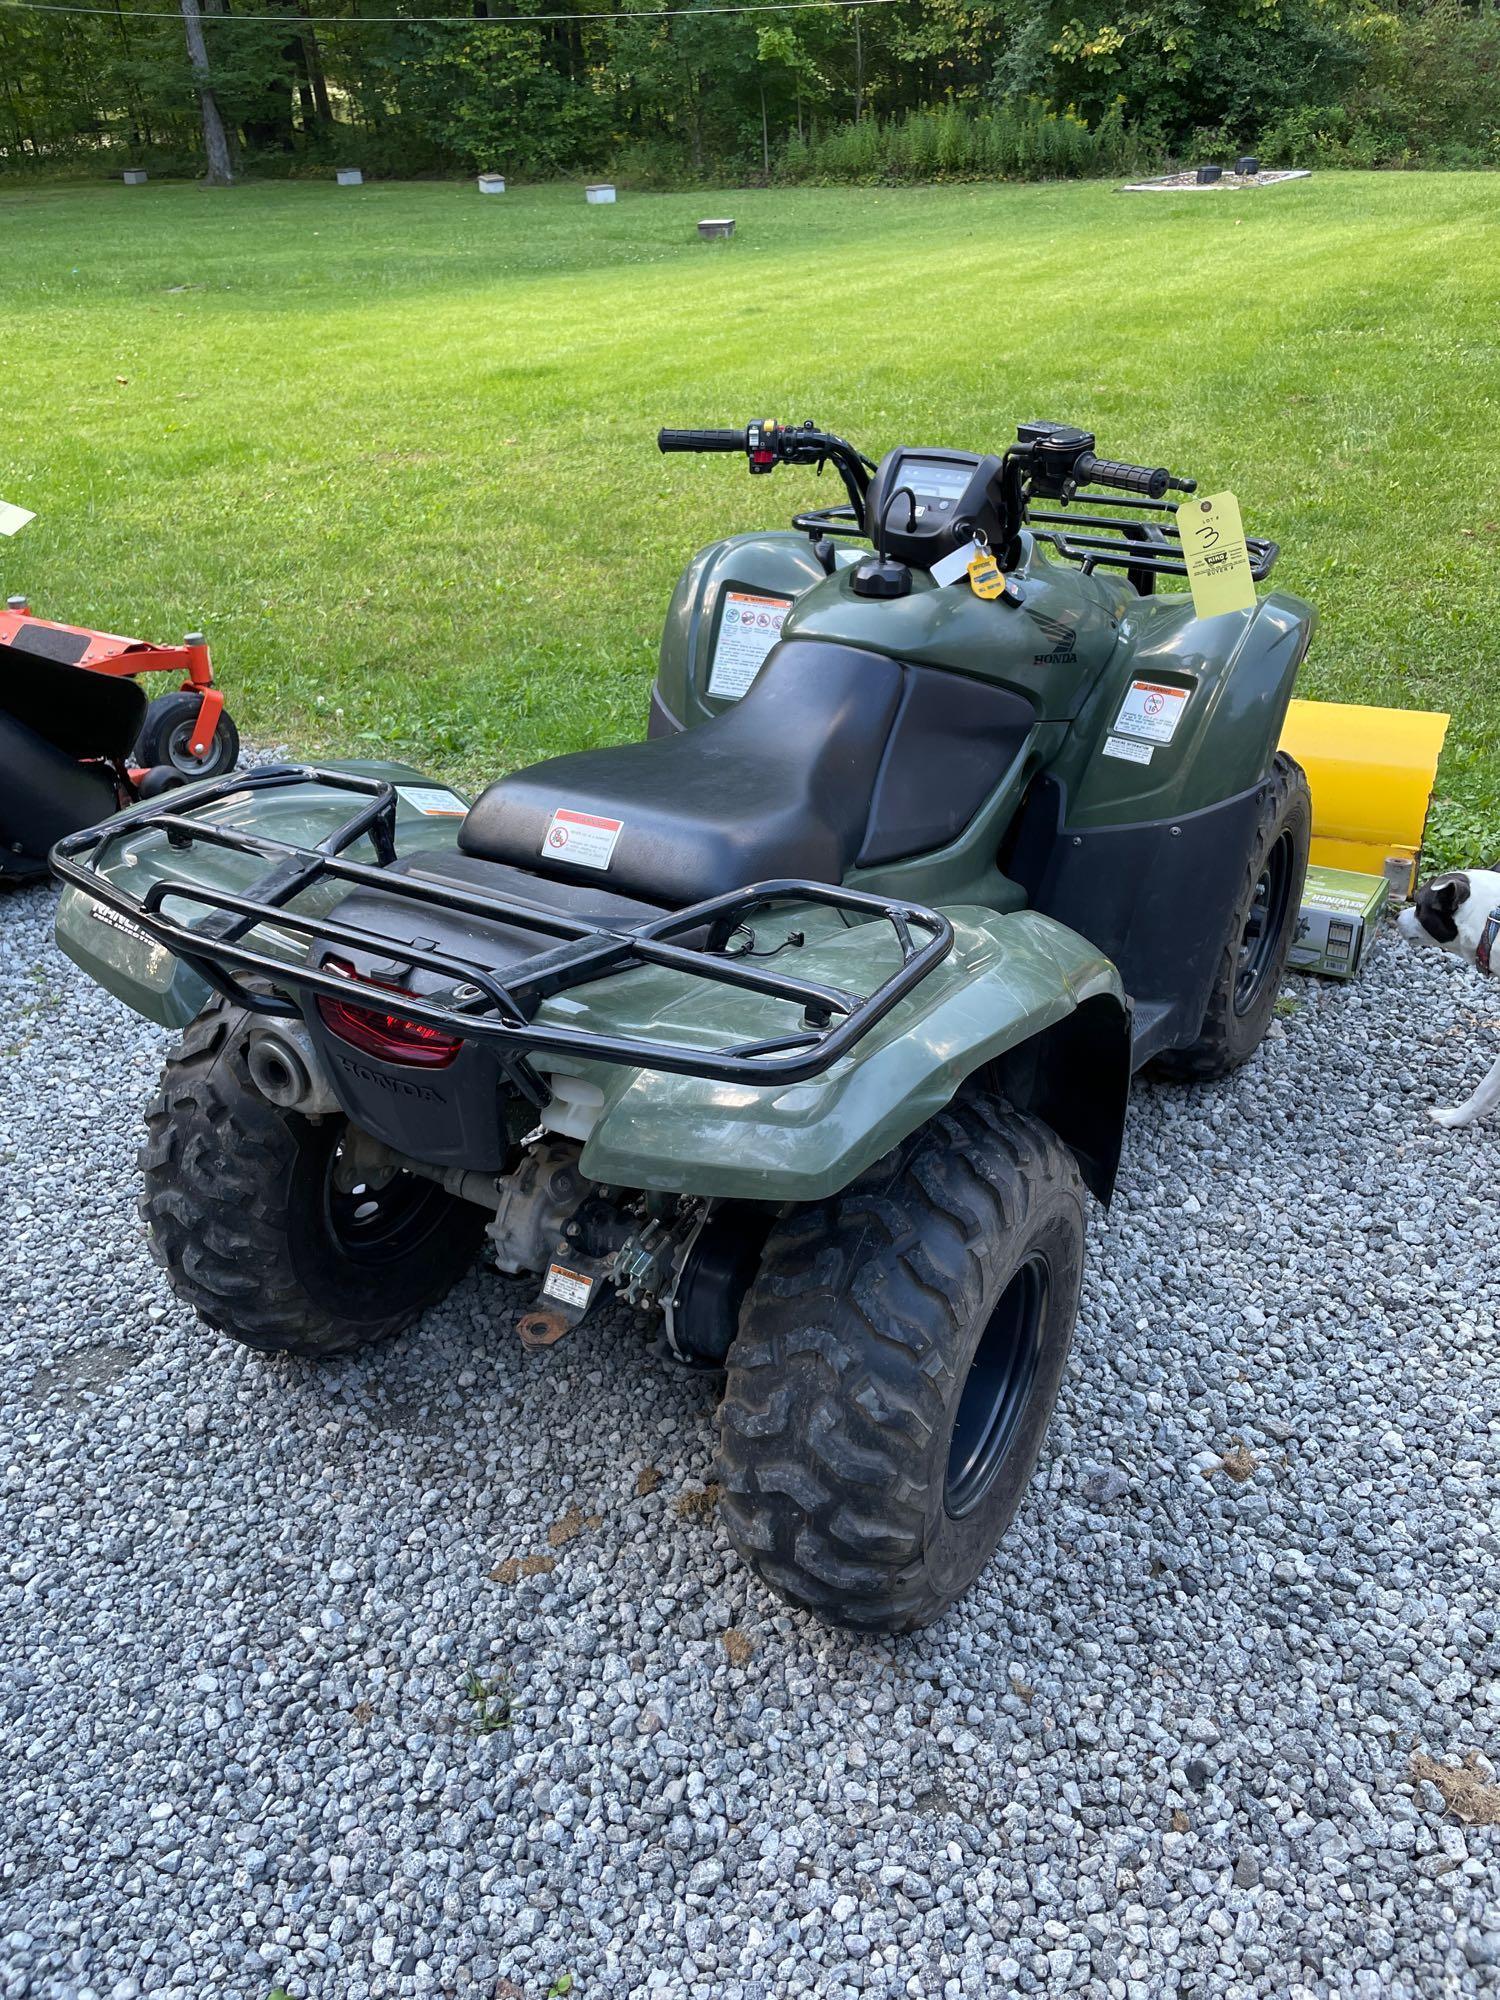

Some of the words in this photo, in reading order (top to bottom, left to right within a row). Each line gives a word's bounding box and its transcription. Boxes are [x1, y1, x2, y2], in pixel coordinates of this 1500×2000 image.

[1203, 516, 1214, 525] LOT
[1195, 526, 1220, 549] 3
[1033, 653, 1078, 665] HONDA
[92, 912, 113, 926] FUEL
[337, 1052, 448, 1104] HONDA
